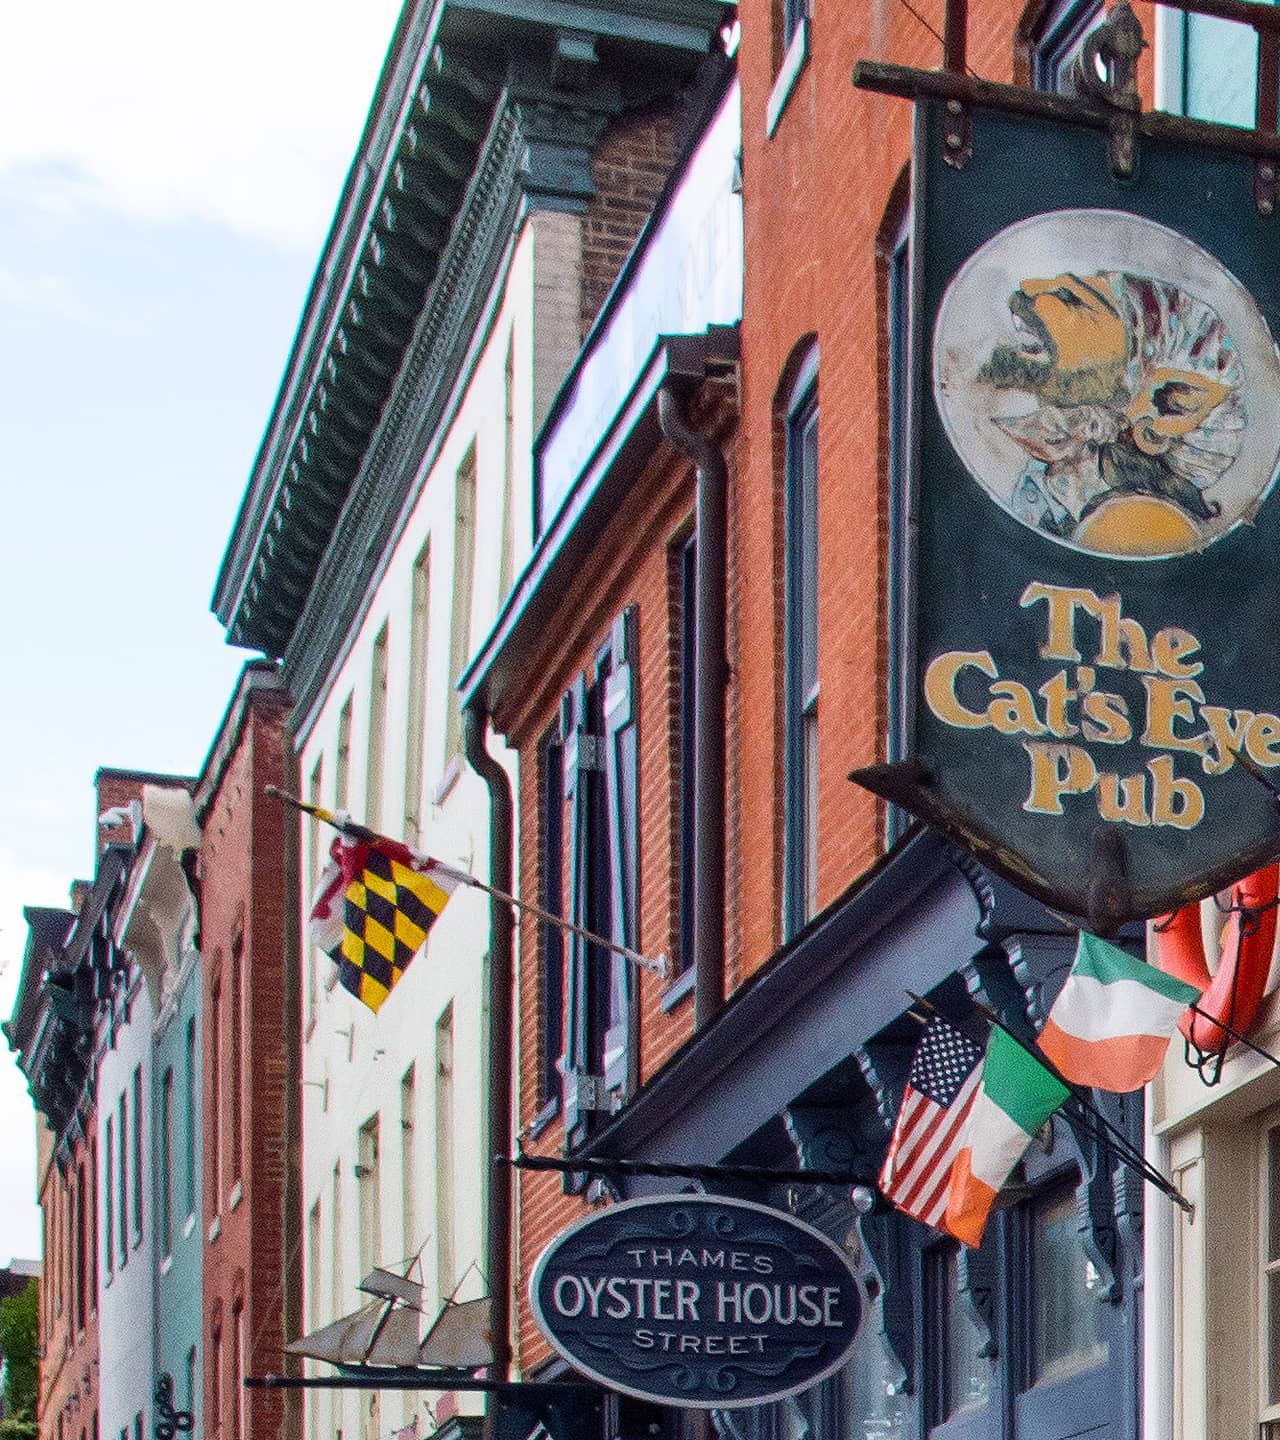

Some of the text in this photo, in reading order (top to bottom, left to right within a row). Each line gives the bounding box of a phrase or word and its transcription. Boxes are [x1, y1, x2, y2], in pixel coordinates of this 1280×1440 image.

[1019, 582, 1205, 678] The
[923, 650, 1132, 747] Cat's
[1022, 741, 1207, 830] Pub
[627, 1248, 774, 1274] THAMES
[554, 1275, 843, 1327] OYSTER HOUSE
[632, 1329, 769, 1355] STREET
